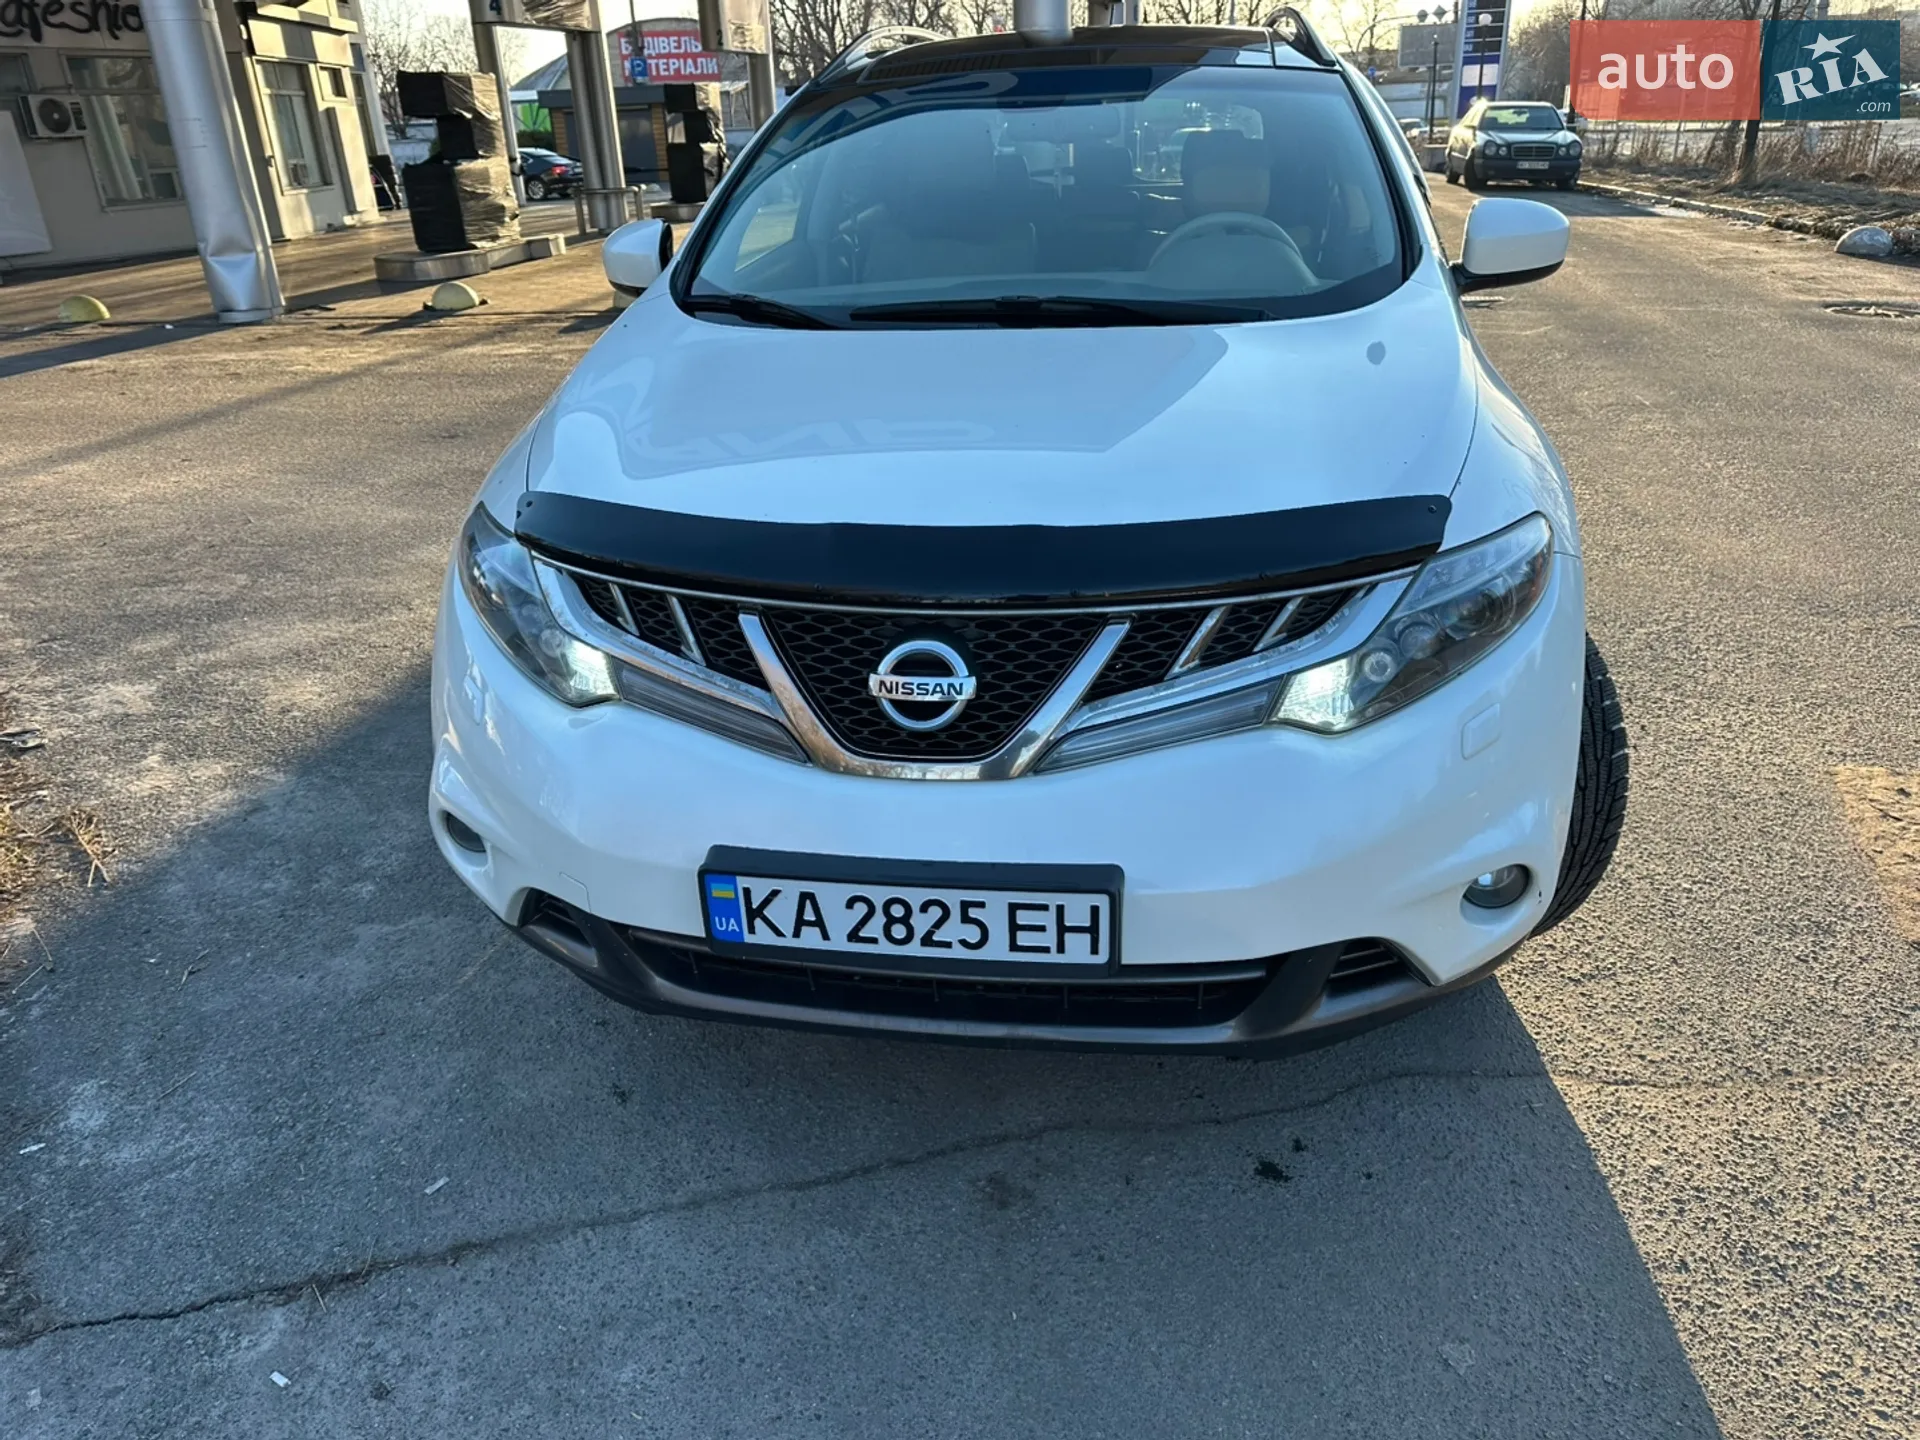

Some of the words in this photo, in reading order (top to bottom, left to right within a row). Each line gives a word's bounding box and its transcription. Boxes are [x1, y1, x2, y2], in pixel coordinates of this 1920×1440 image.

[489, 0, 501, 15] 4
[620, 36, 702, 57] БДІВЕЛЬ
[633, 60, 644, 73] P
[878, 680, 964, 696] NISSAN
[715, 916, 740, 932] UA
[742, 886, 831, 941] KA
[845, 894, 989, 950] 2825
[1008, 902, 1100, 955] EH
